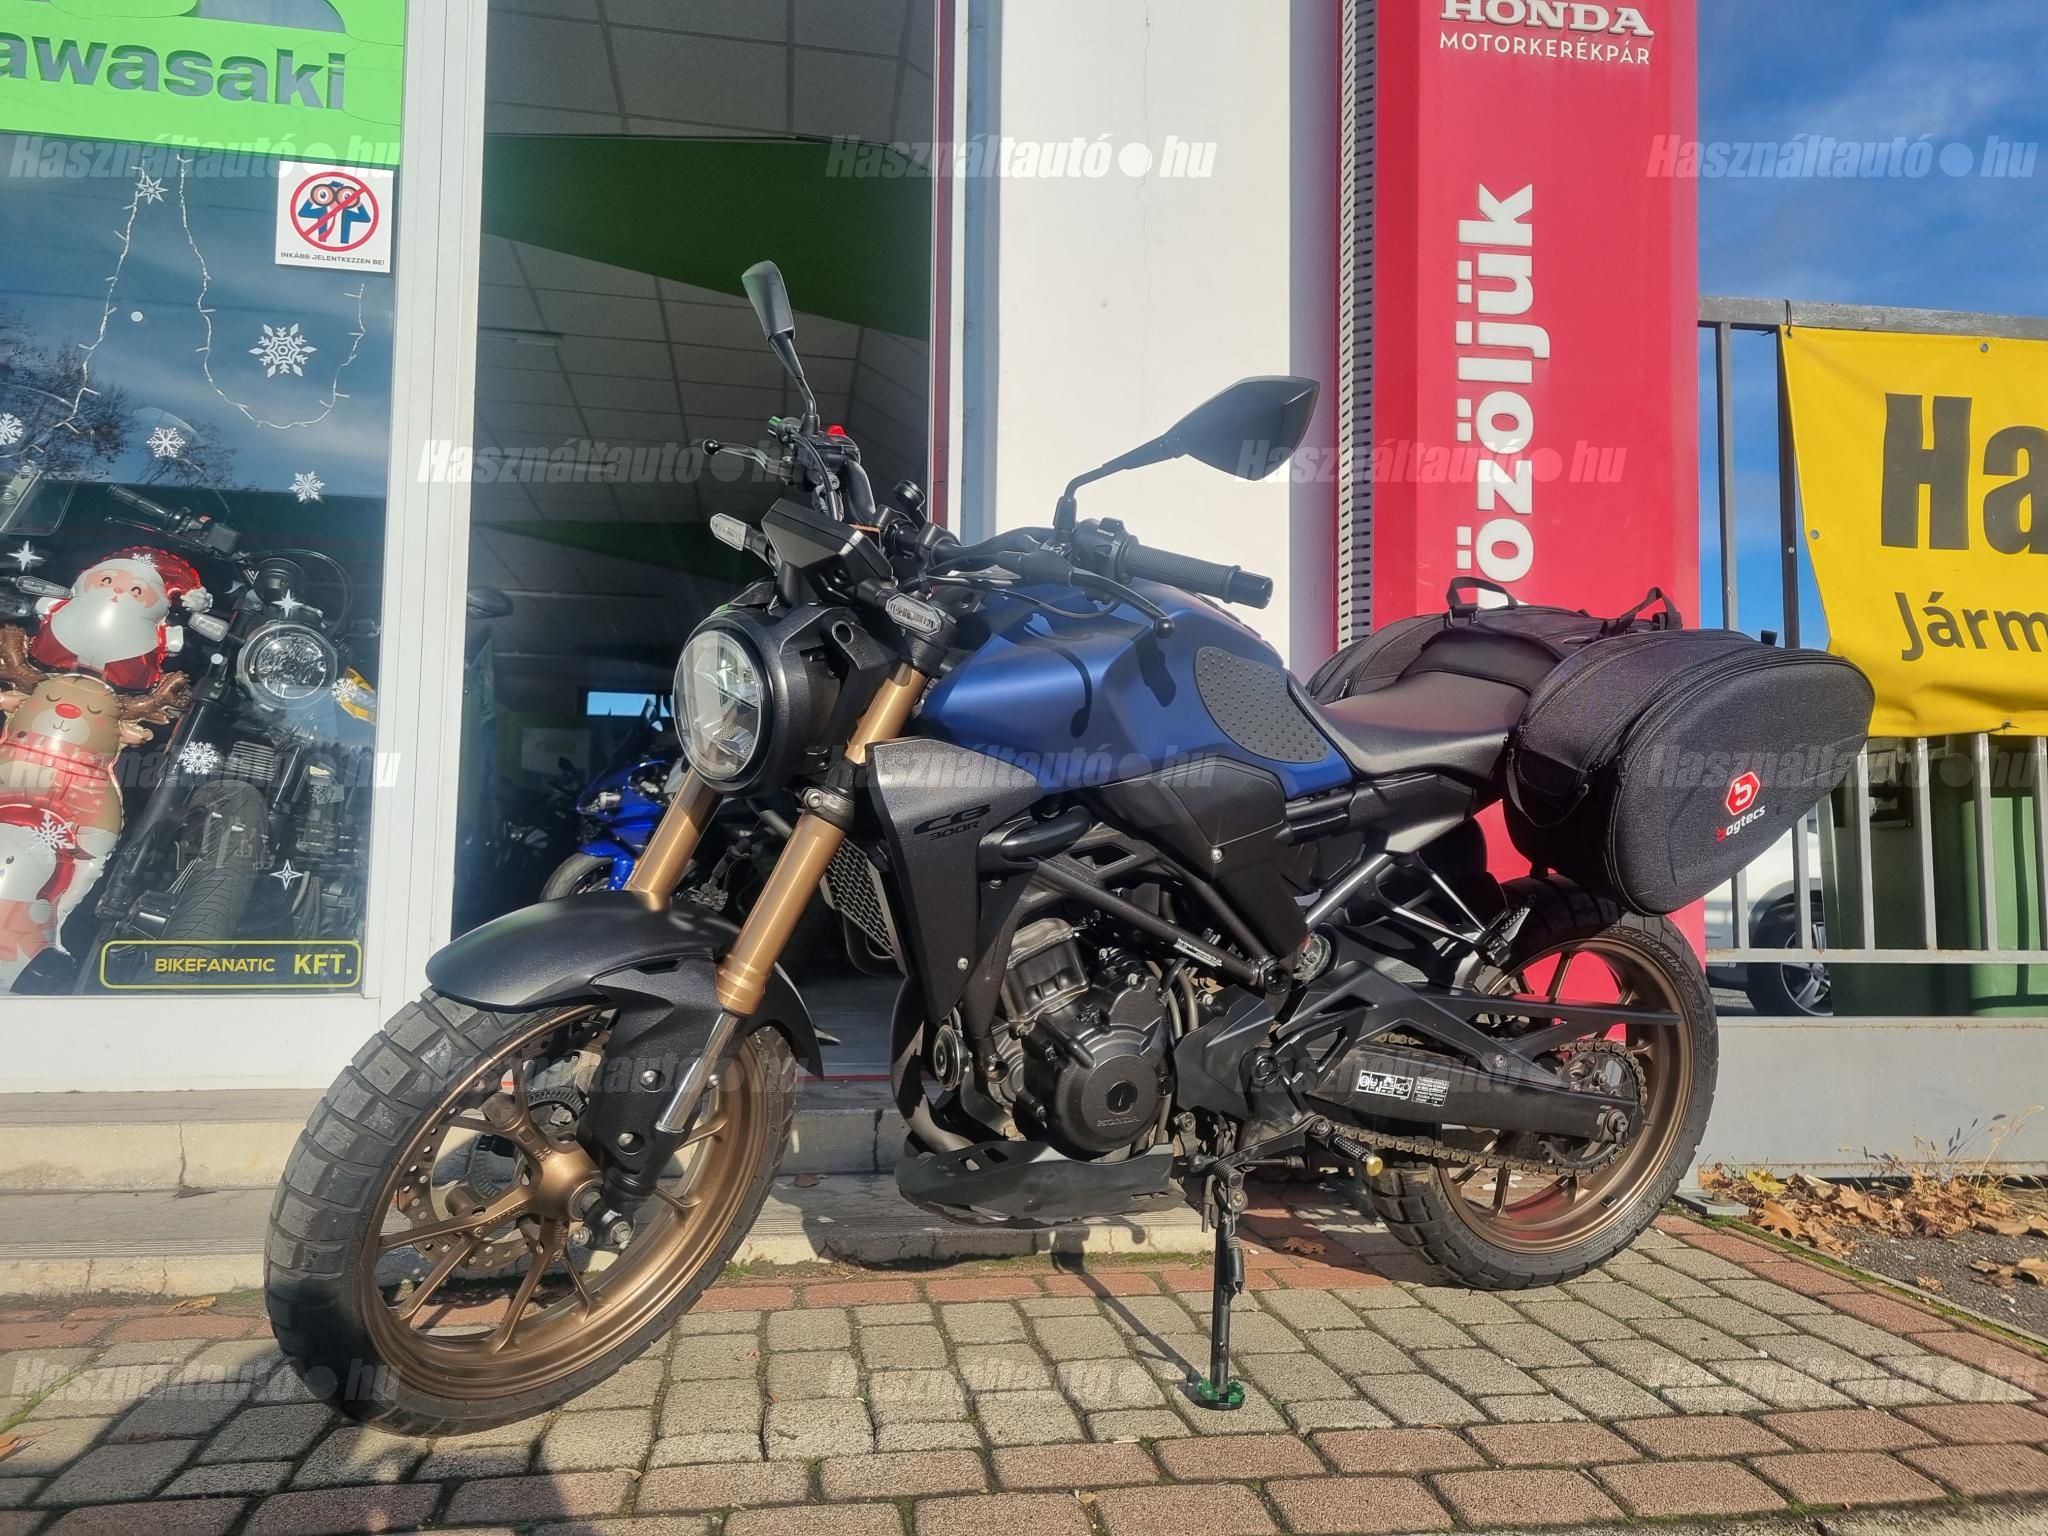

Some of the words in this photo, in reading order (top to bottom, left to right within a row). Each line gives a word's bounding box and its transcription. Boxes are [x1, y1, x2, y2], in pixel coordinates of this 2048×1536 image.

[1440, 0, 1655, 38] HONDA
[1439, 31, 1650, 65] MOTORKERÉKPÁR
[1881, 392, 2048, 555] Ha
[1894, 591, 2048, 662] Járm
[154, 957, 276, 973] BIKEFANATIC
[294, 953, 352, 975] KFT.
